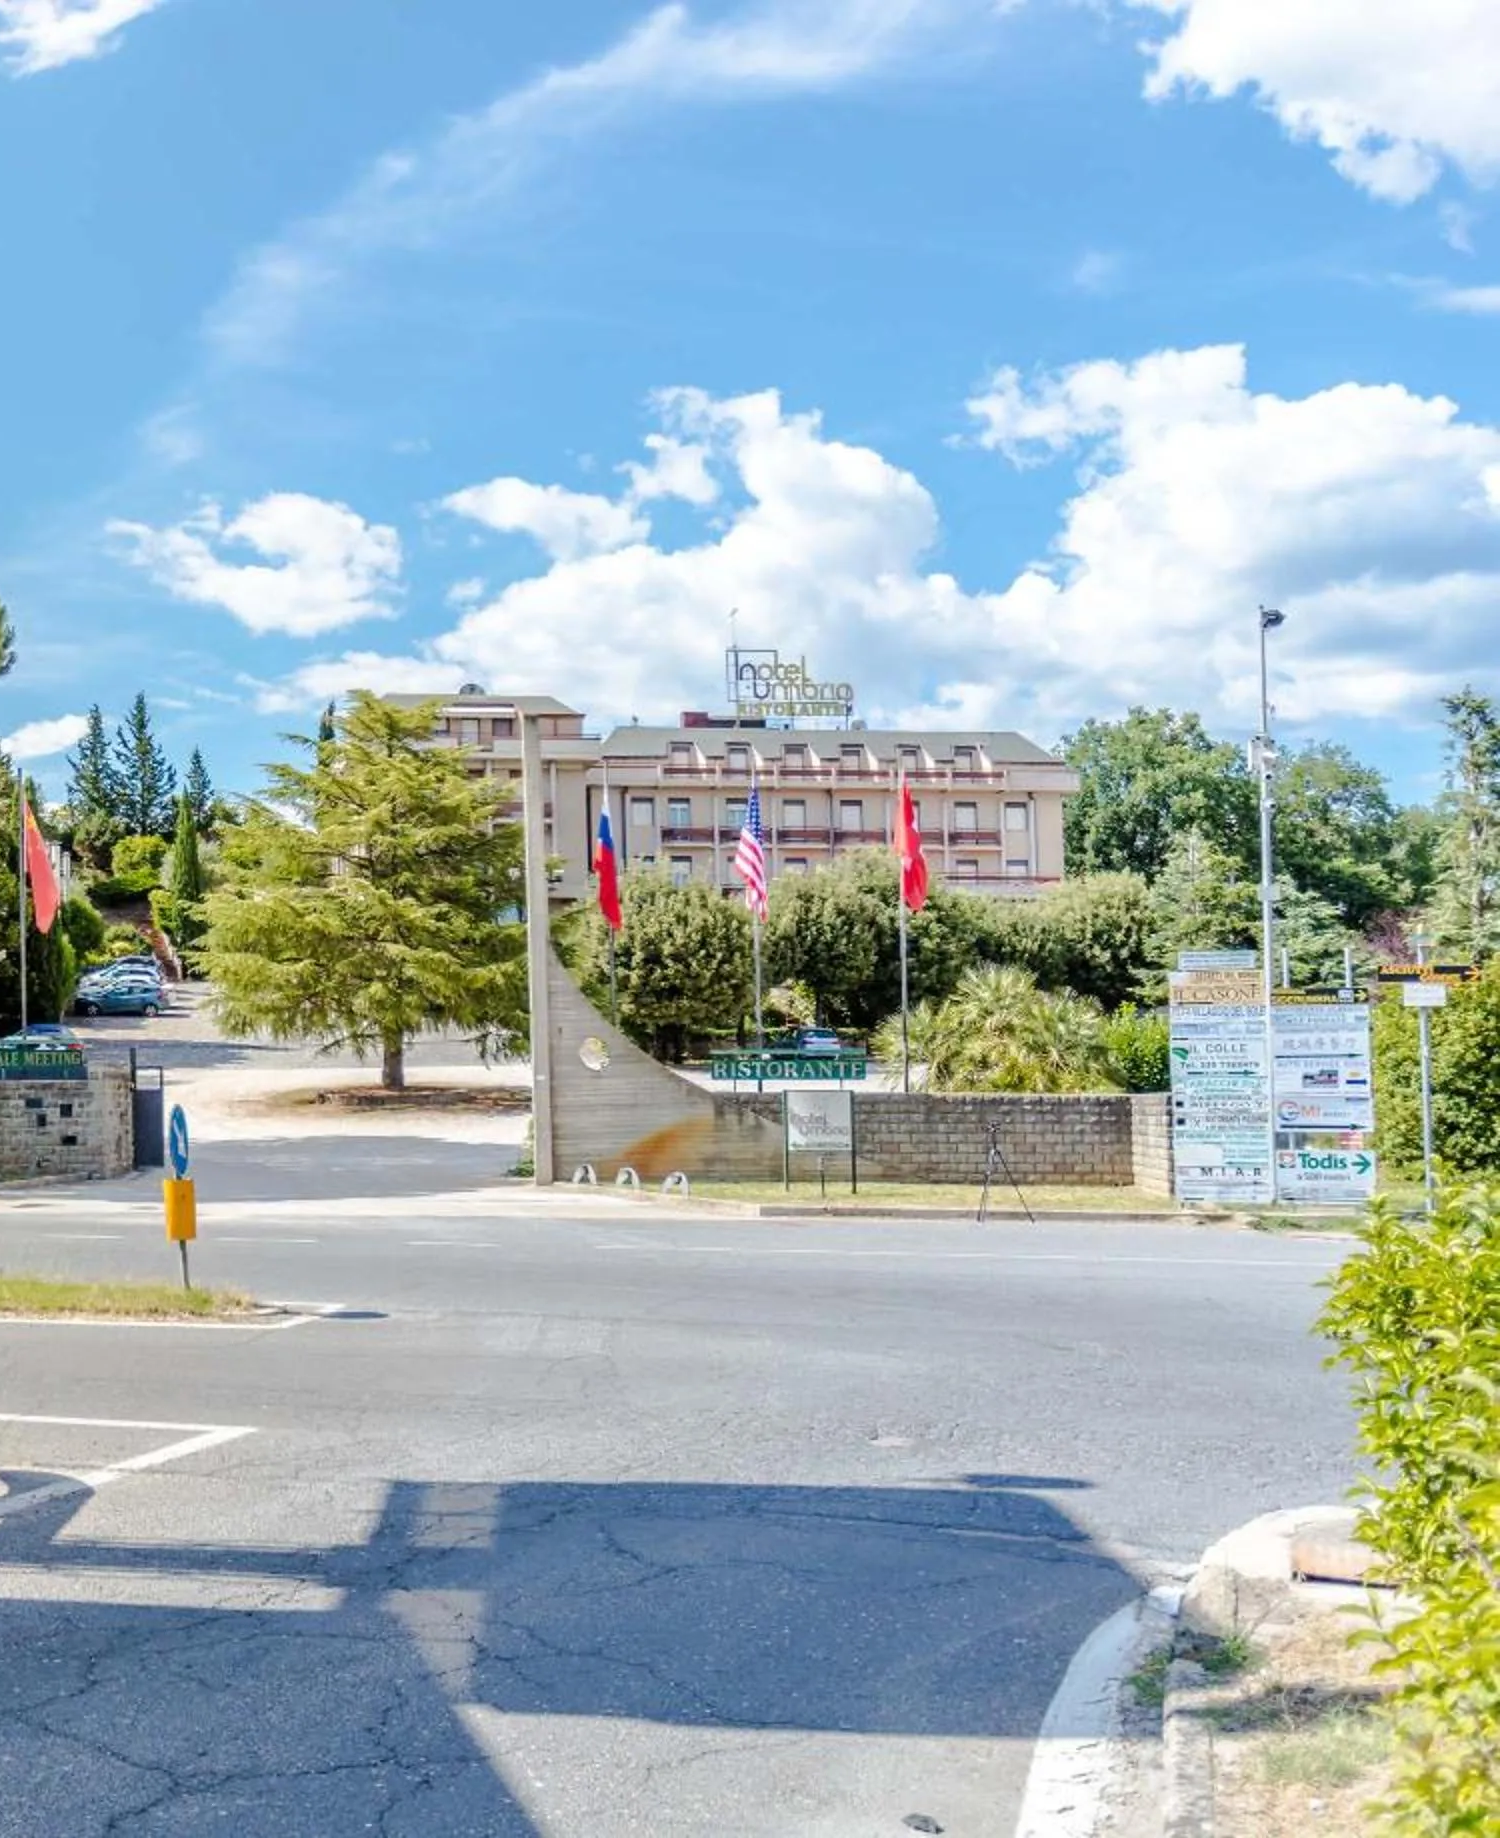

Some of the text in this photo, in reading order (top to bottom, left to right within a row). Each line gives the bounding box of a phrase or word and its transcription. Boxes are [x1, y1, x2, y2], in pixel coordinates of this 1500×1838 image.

[737, 702, 852, 716] RISTORANTE
[712, 1061, 863, 1078] RISTORANTE
[1298, 1152, 1348, 1169] Todis
